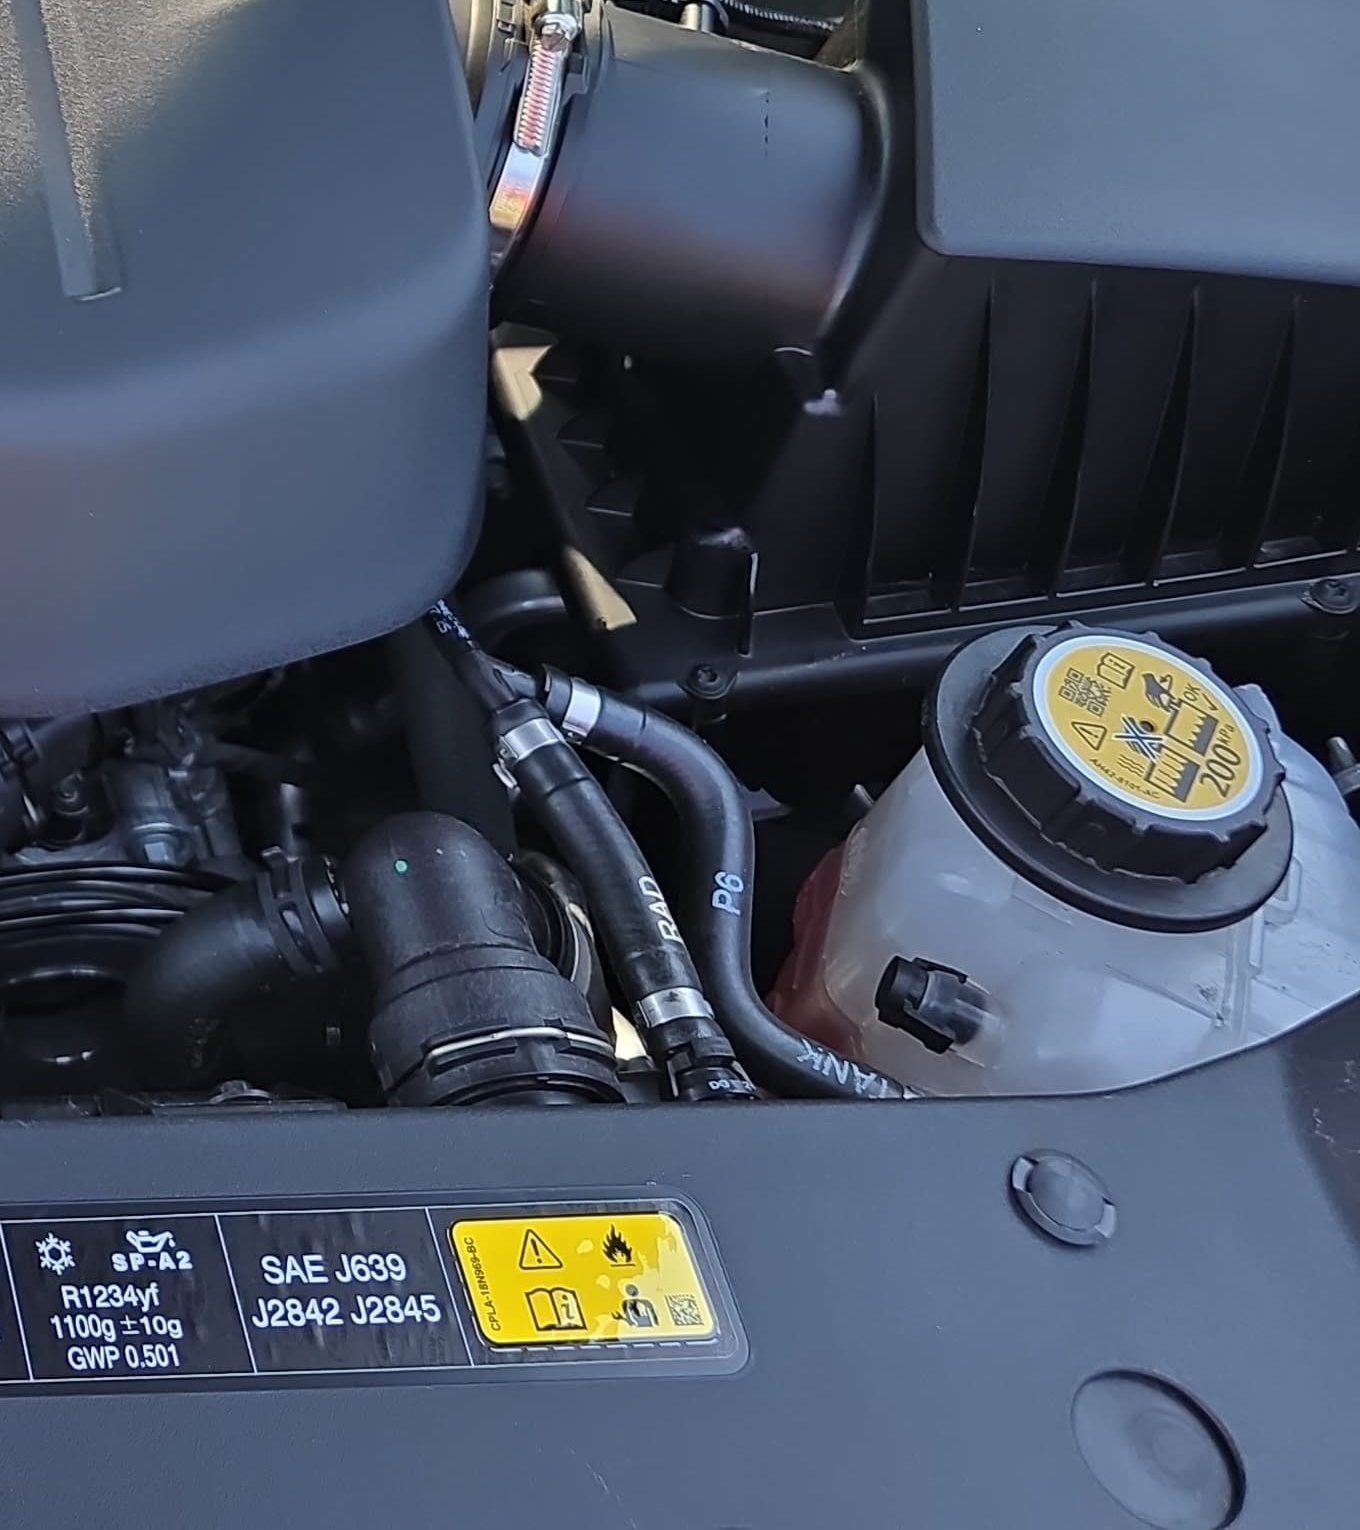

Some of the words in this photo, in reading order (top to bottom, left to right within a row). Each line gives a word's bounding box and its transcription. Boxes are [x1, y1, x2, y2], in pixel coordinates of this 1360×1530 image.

[1182, 682, 1201, 702] OK
[1216, 723, 1236, 747] kPa
[1199, 743, 1242, 798] 200
[637, 875, 684, 943] RAD
[711, 870, 745, 917] P6
[795, 1037, 890, 1100] TANK
[111, 1251, 194, 1272] SP-A2
[260, 1254, 329, 1285] SAE
[334, 1253, 408, 1283] J639
[60, 1282, 161, 1312] R1234yf
[251, 1297, 345, 1329] J2842
[350, 1294, 442, 1324] J2845
[50, 1314, 116, 1342] 1100g
[121, 1315, 184, 1341] ±10g
[67, 1346, 121, 1371] GWP
[124, 1343, 181, 1369] 0.501
